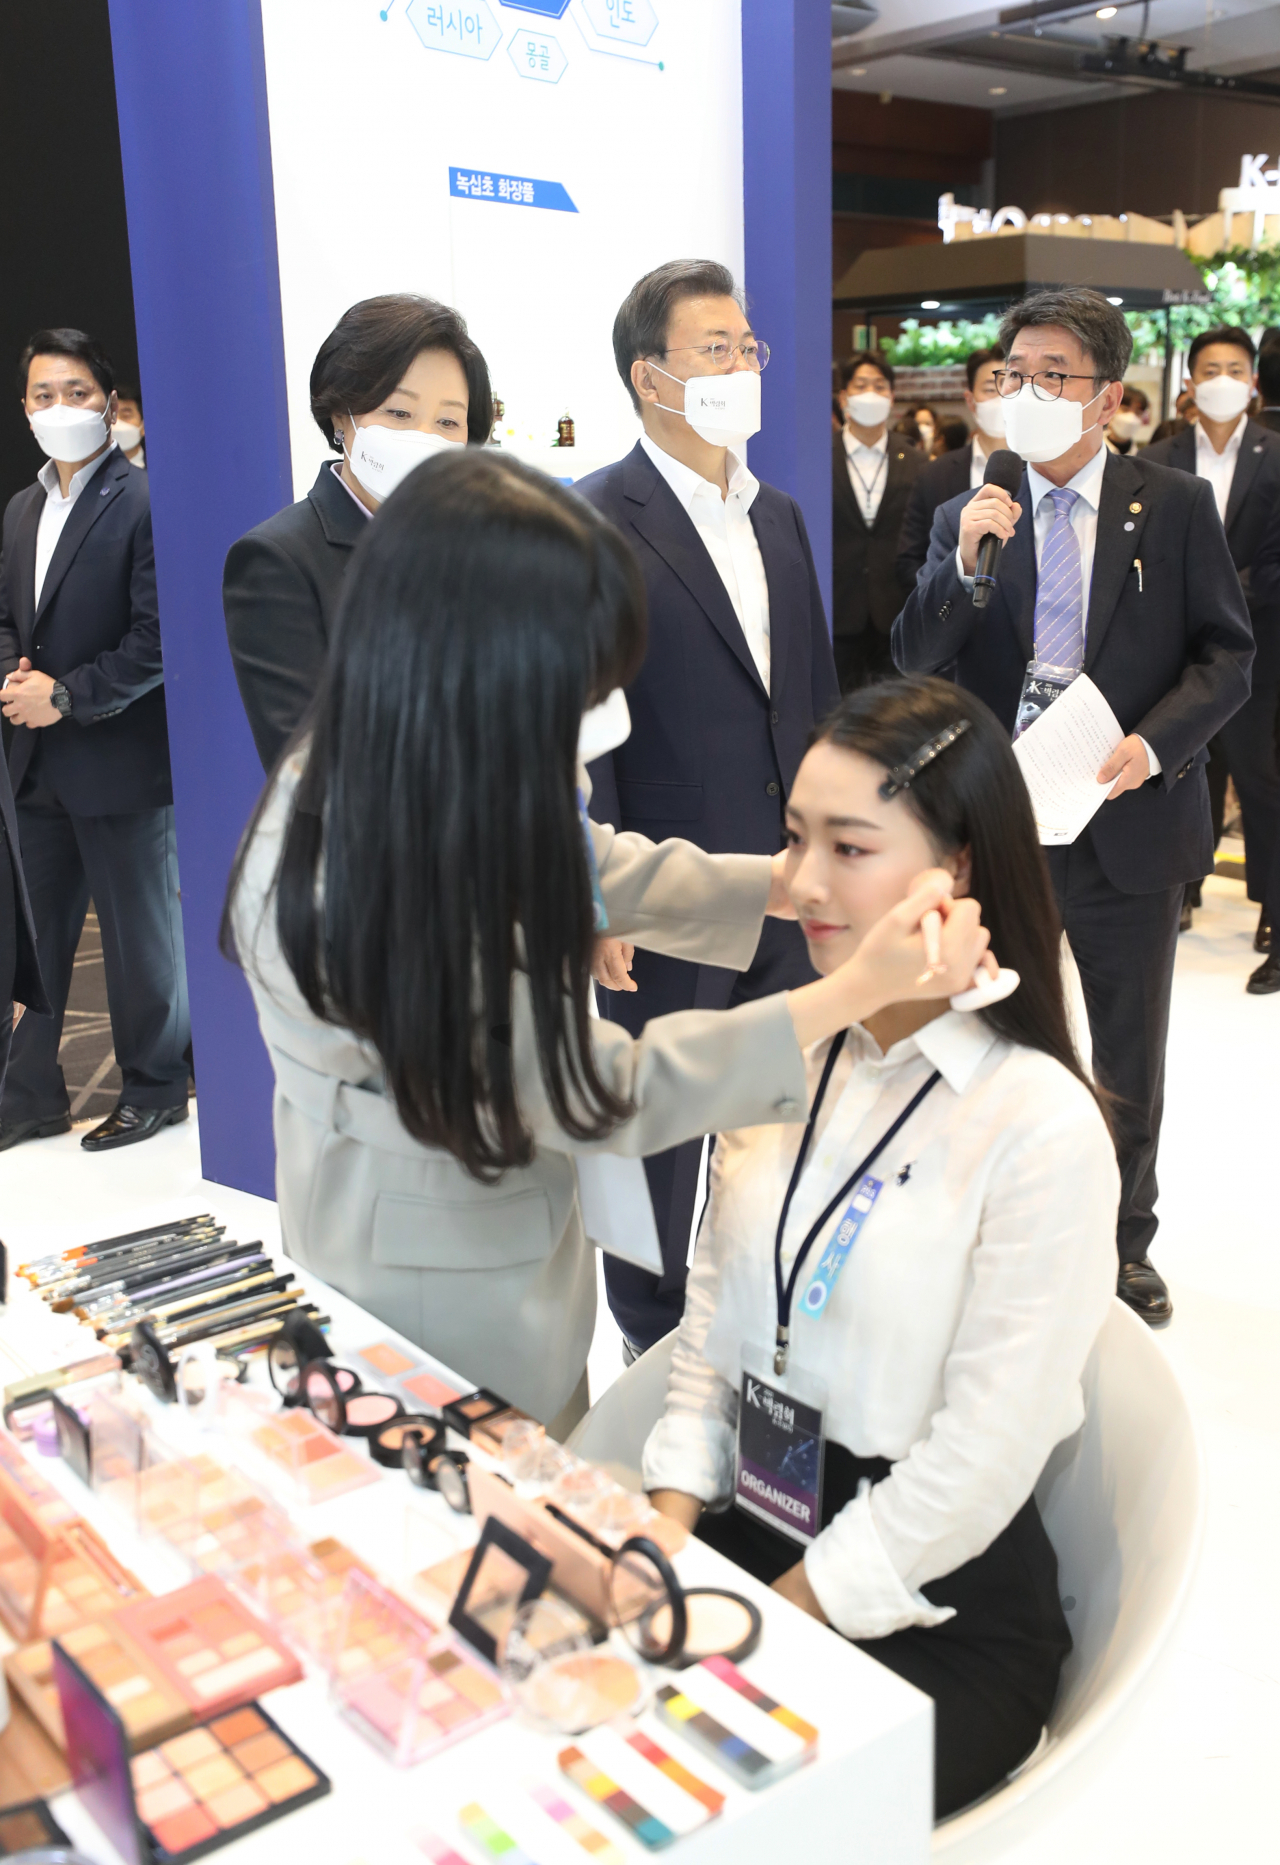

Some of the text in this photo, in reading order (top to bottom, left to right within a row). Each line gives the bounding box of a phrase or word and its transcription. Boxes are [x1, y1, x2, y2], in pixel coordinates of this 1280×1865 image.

[427, 4, 483, 44] 러시아
[605, 0, 636, 28] 인도
[525, 41, 551, 71] 몽골
[1240, 153, 1280, 187] K-
[456, 171, 535, 203] 녹십초 화장품
[741, 1469, 811, 1524] ORGANIZER
